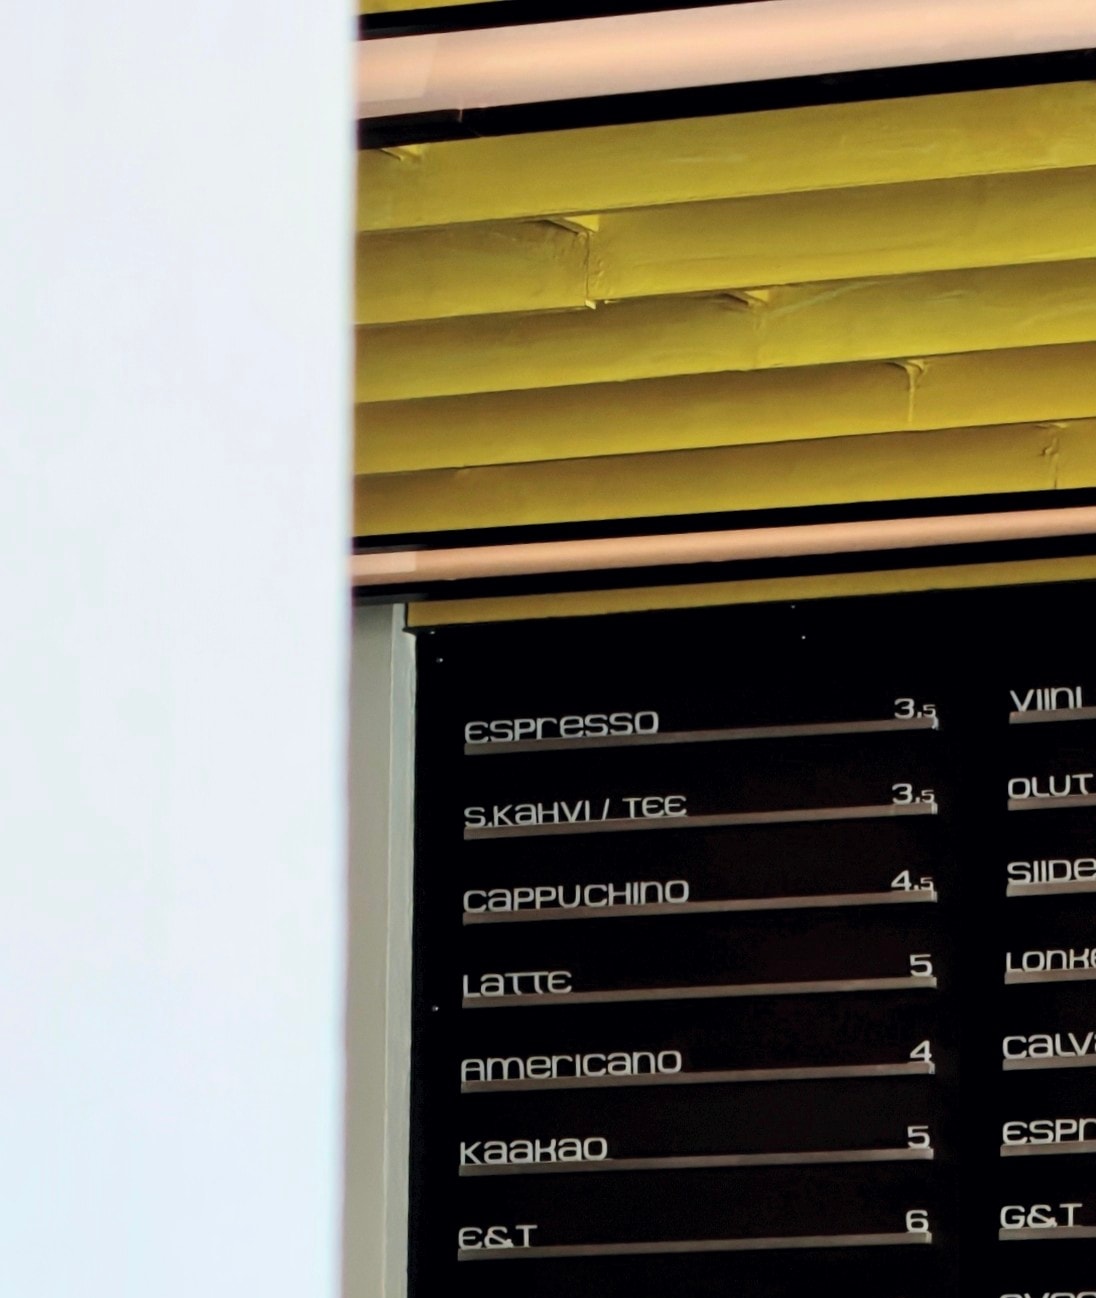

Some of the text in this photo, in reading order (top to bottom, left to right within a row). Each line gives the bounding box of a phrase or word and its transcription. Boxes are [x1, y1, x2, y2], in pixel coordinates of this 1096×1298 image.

[1010, 686, 1082, 713] VIINI
[465, 711, 659, 744] ESPRESSO
[1007, 773, 1094, 799] OLUT
[602, 798, 611, 821] /
[622, 795, 687, 819] TEE
[463, 880, 689, 913] CAPPUCHINO
[463, 954, 933, 998] LATTE 5
[461, 1041, 932, 1082] AMERICANO 4
[460, 1126, 931, 1166] KAAKAO 5
[458, 1210, 929, 1249] E&T 6
[1000, 1202, 1083, 1229] G&T
